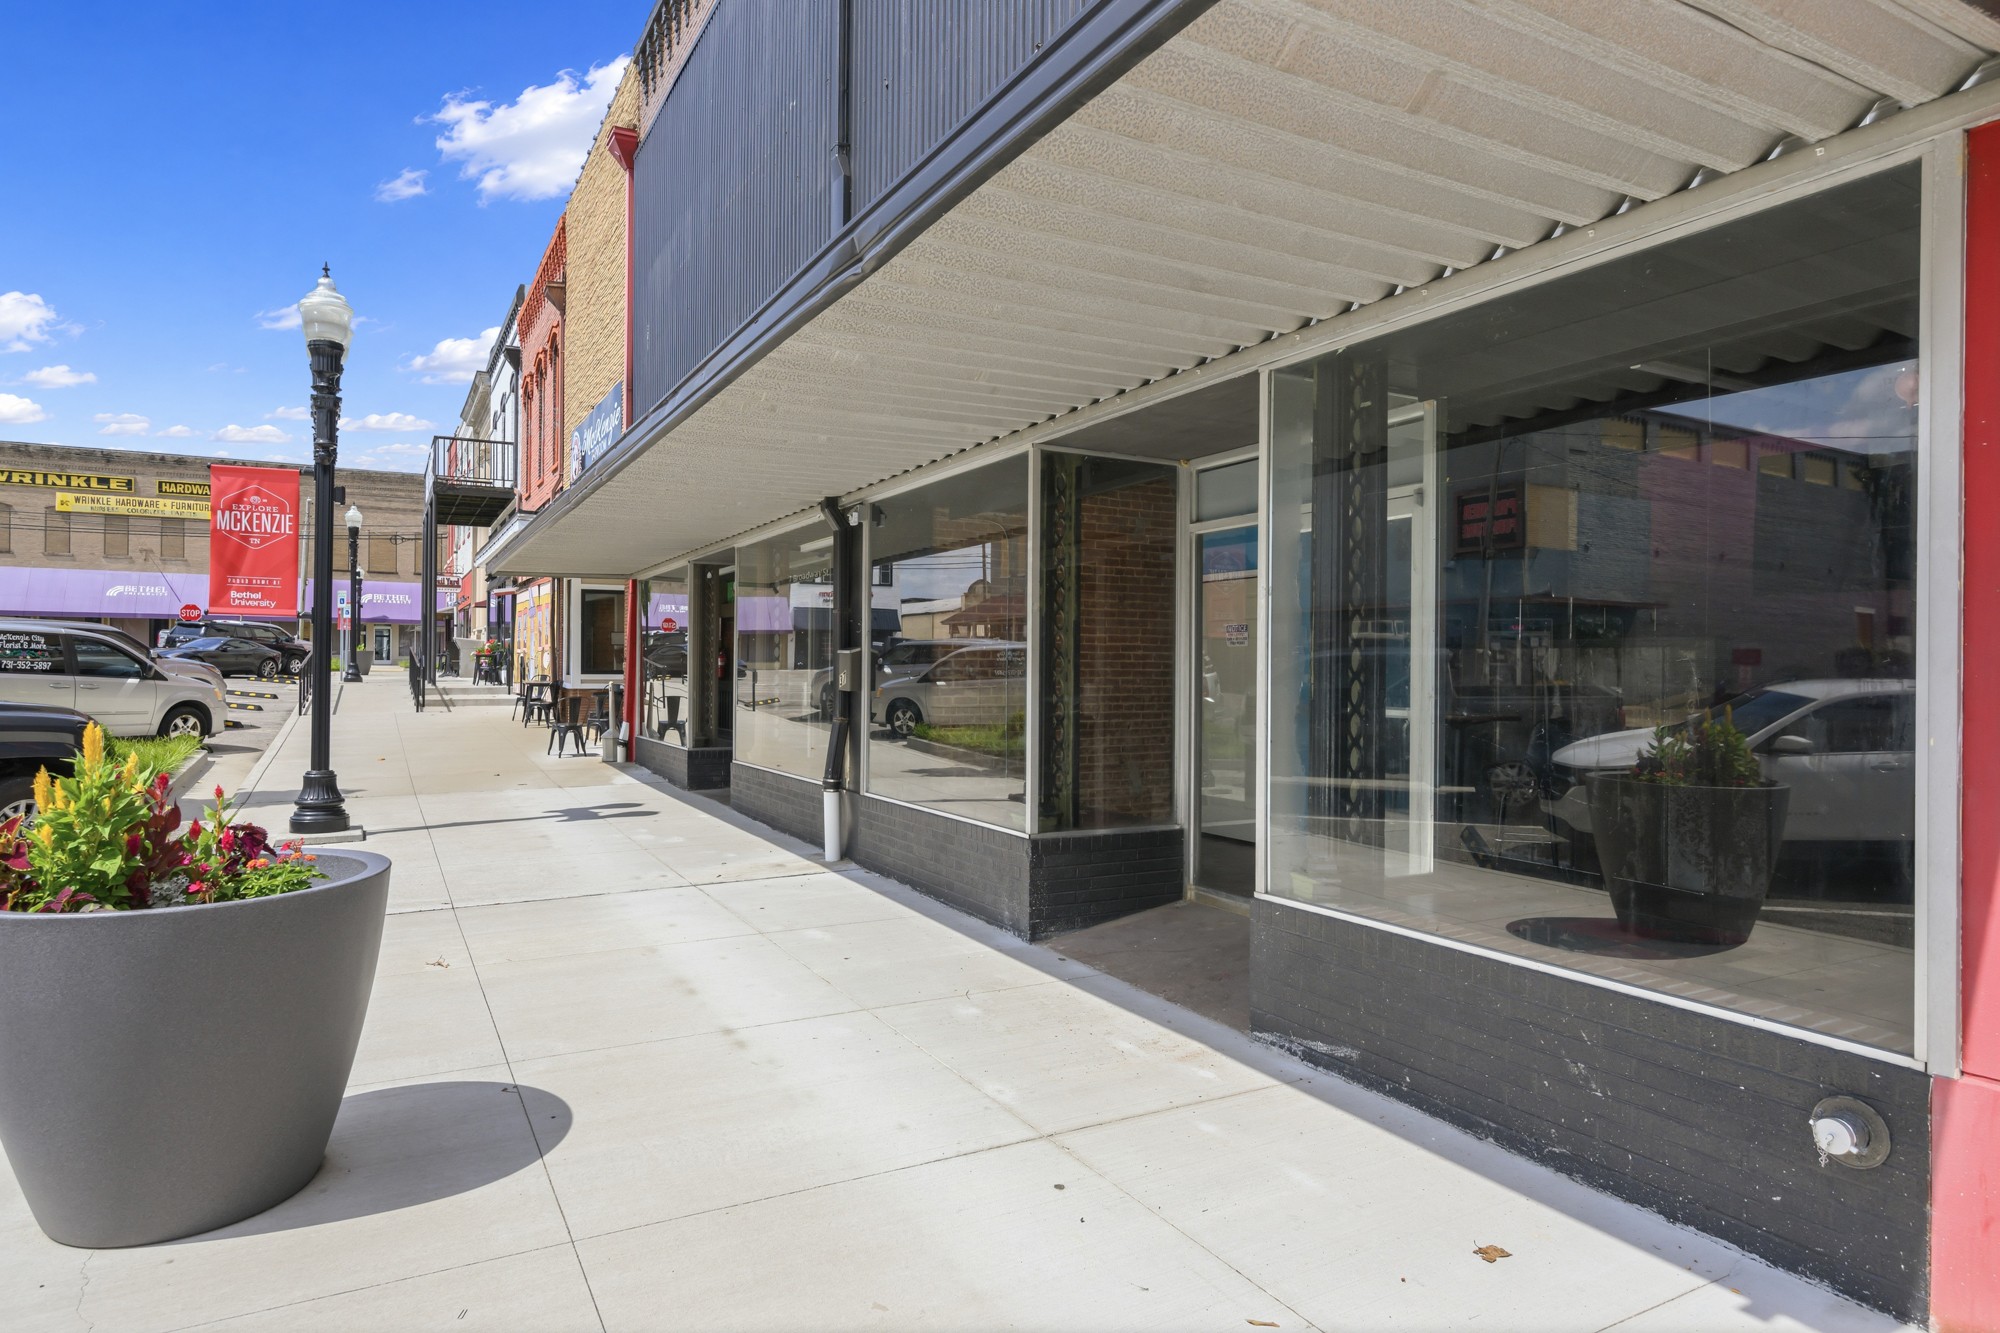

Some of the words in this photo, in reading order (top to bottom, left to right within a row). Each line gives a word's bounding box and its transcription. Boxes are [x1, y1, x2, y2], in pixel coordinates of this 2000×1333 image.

[162, 482, 211, 495] HARDWA
[74, 495, 111, 506] WRINKLE
[115, 498, 160, 509] HARDWARE
[170, 501, 211, 512] FURNITUR
[232, 503, 279, 513] EXPLORE
[216, 509, 294, 534] MCKENZIE
[124, 585, 168, 593] BETHEL
[230, 590, 262, 600] Bethel
[373, 593, 411, 601] BETHEL
[230, 598, 277, 609] University
[181, 609, 201, 618] STOP
[31, 634, 45, 644] City
[1, 660, 52, 670] 731-352-5897
